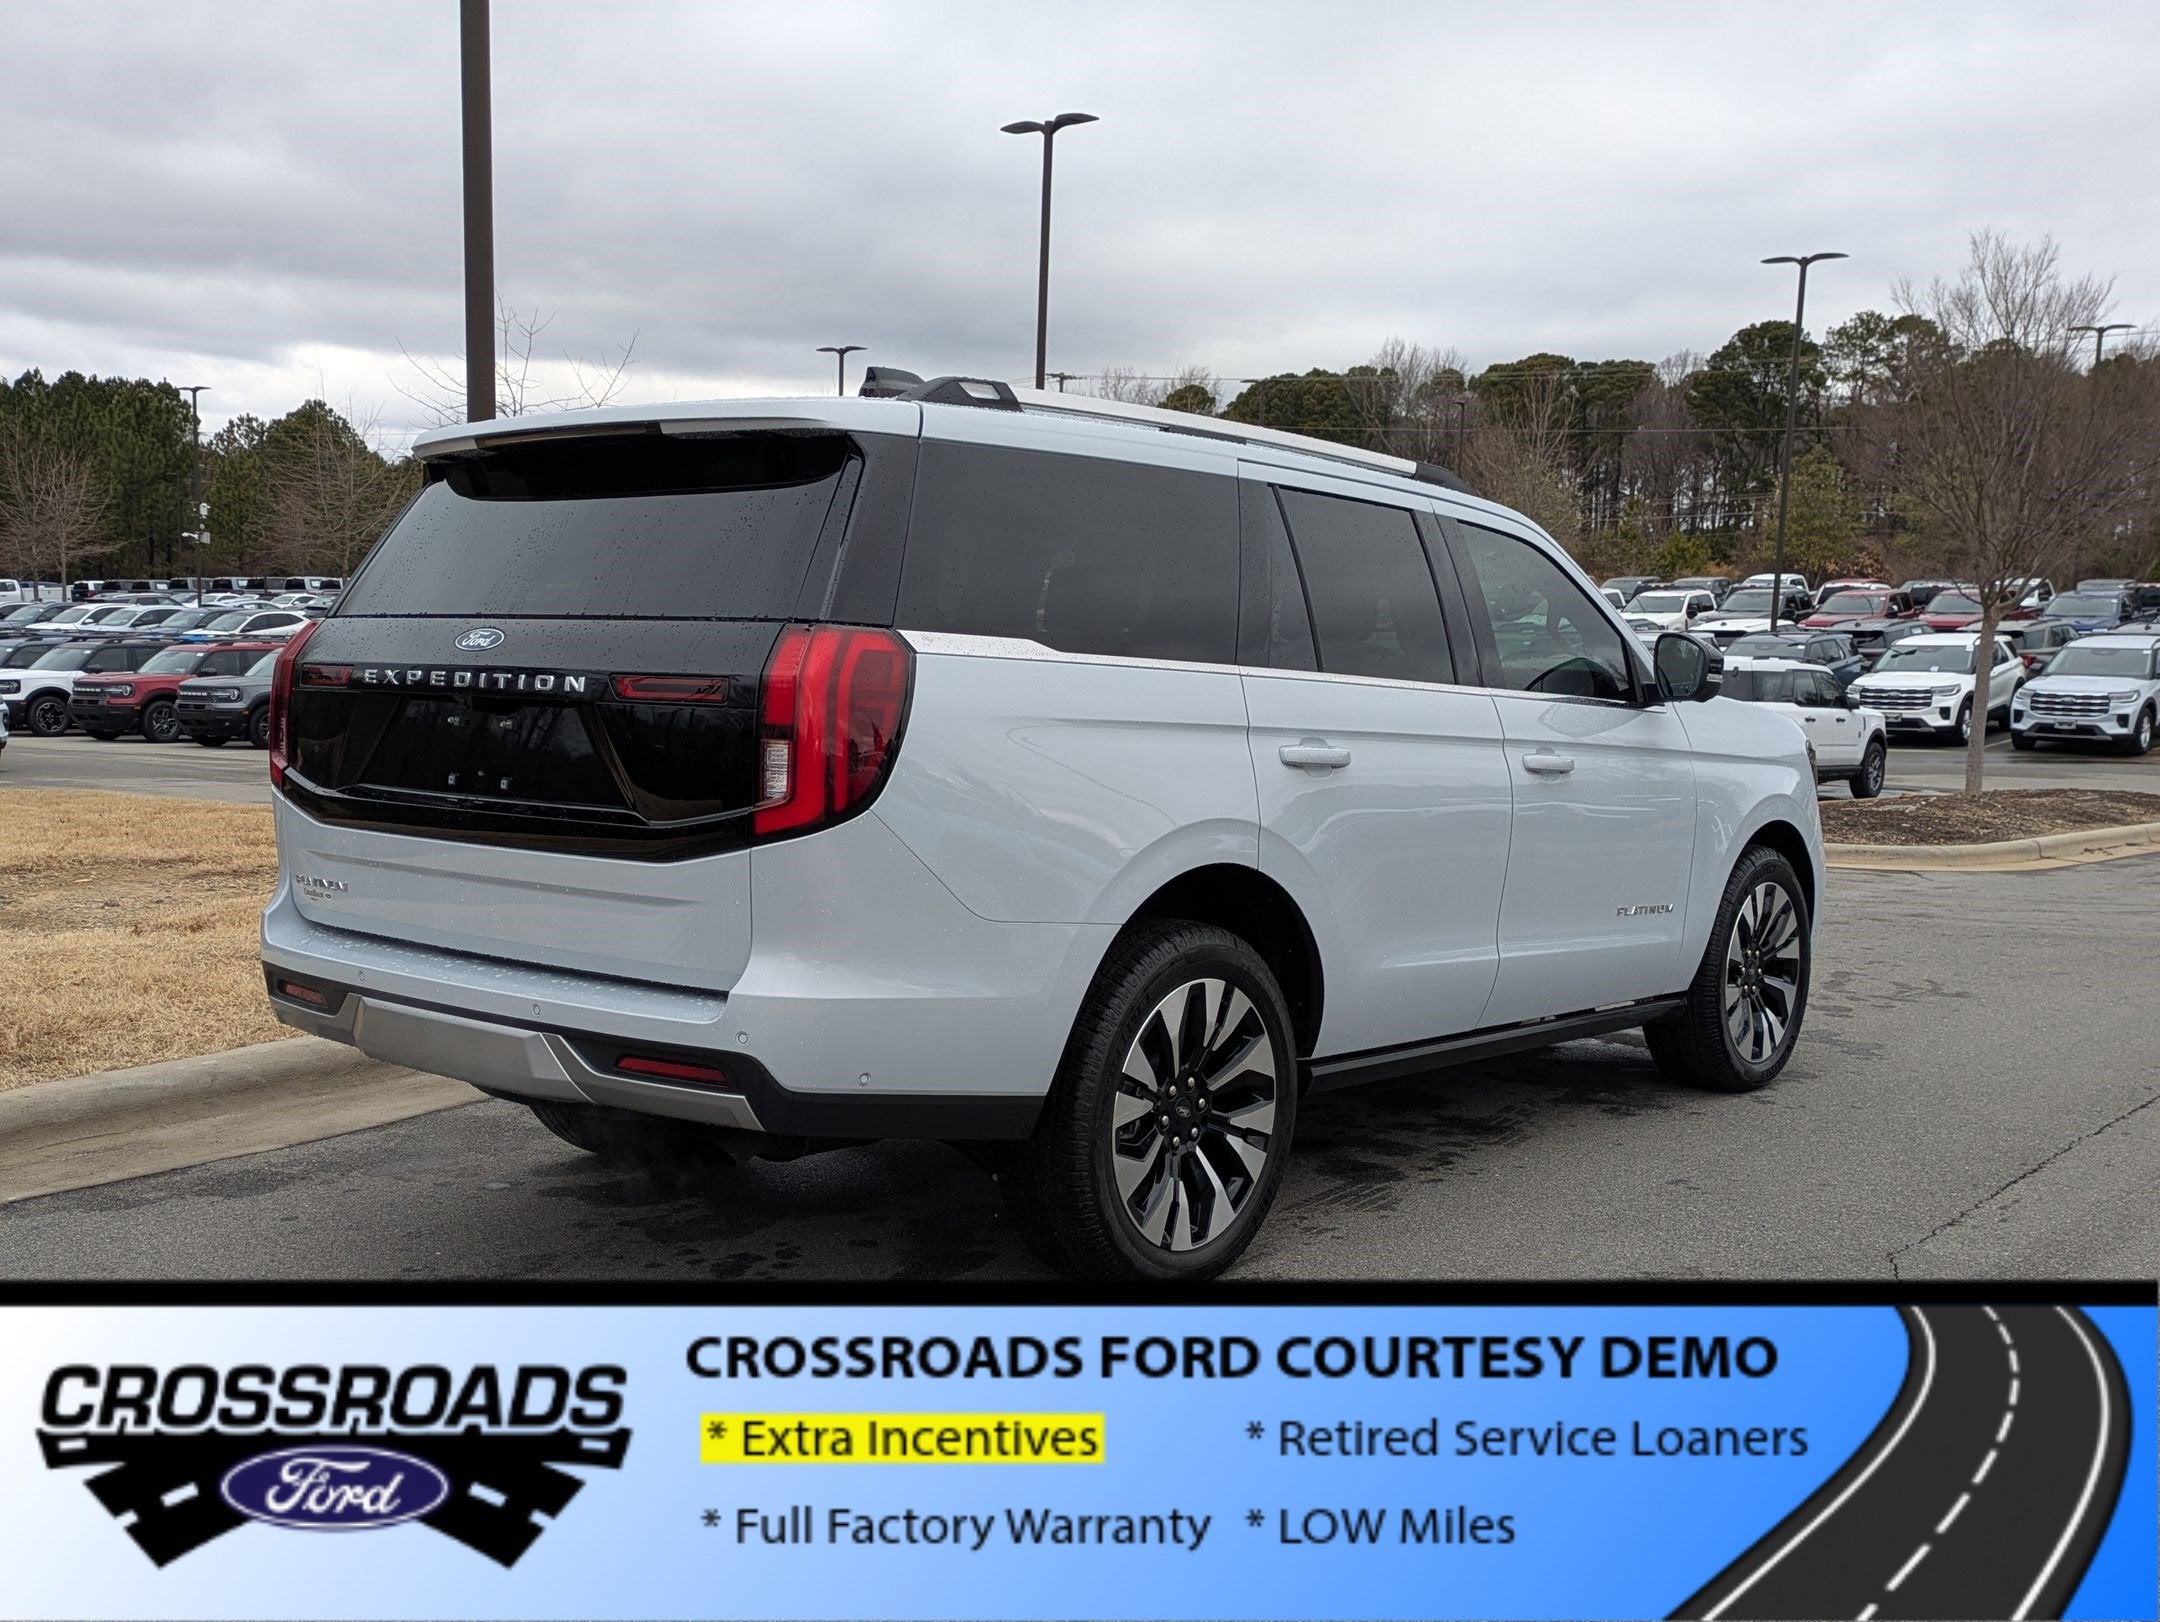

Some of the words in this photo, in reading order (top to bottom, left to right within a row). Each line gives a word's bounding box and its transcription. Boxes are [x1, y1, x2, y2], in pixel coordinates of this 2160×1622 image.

[461, 631, 496, 647] Ford
[363, 669, 586, 693] EXPEDITION
[1616, 903, 1675, 917] PLATINUM
